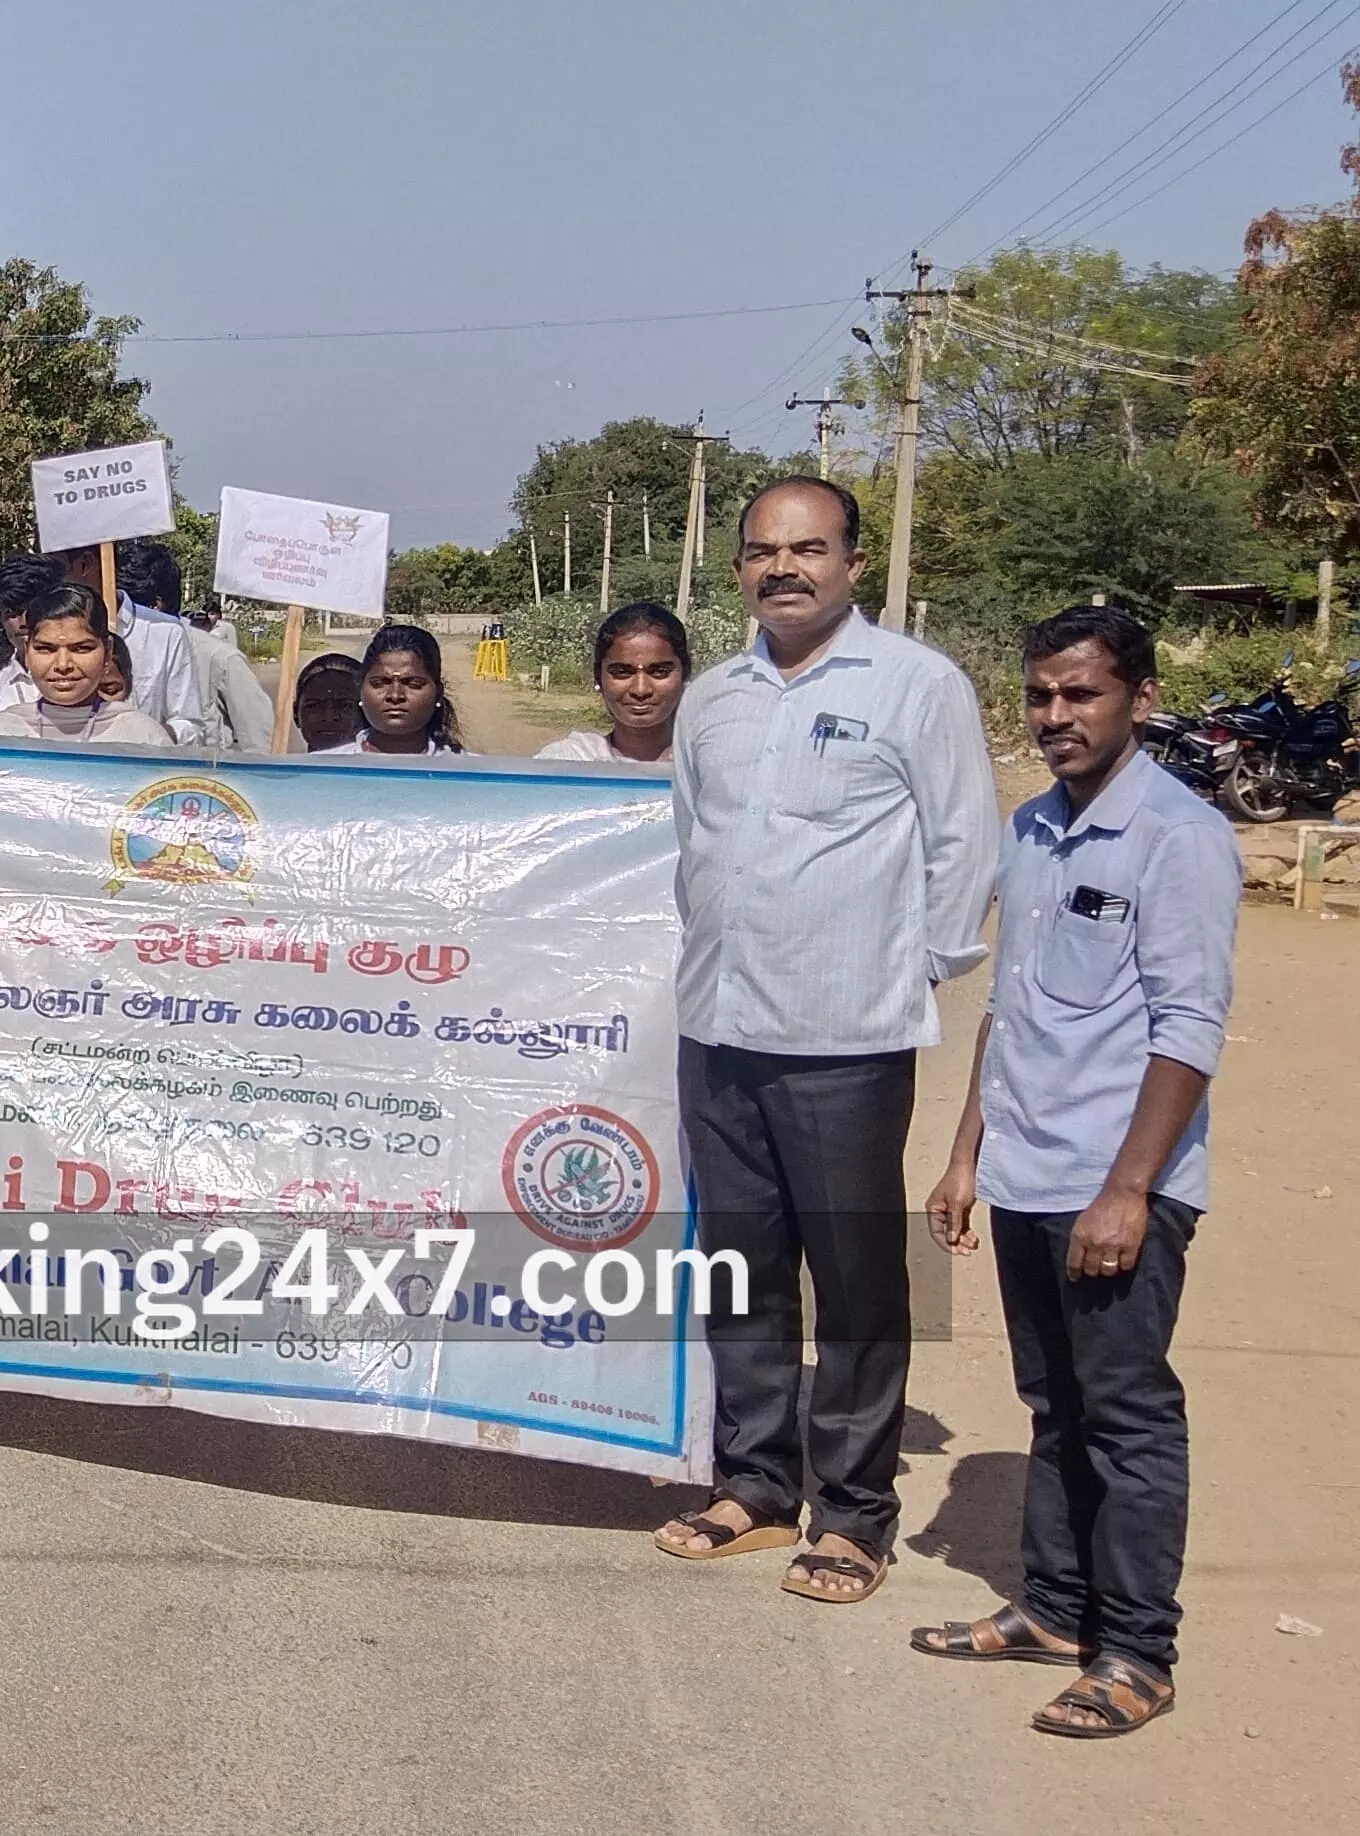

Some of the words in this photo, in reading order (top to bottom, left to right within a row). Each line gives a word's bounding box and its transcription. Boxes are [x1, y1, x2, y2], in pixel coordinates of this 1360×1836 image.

[54, 490, 78, 505] TO
[83, 479, 147, 501] DRUGS
[64, 465, 100, 483] SAY
[106, 460, 133, 477] NO
[348, 938, 471, 985] குழு
[120, 990, 241, 1026] அரசு
[254, 999, 421, 1038] கலைக்
[528, 1184, 555, 1216] DRIVE
[555, 1214, 606, 1230] AGAINST
[608, 1195, 636, 1224] DRUGS
